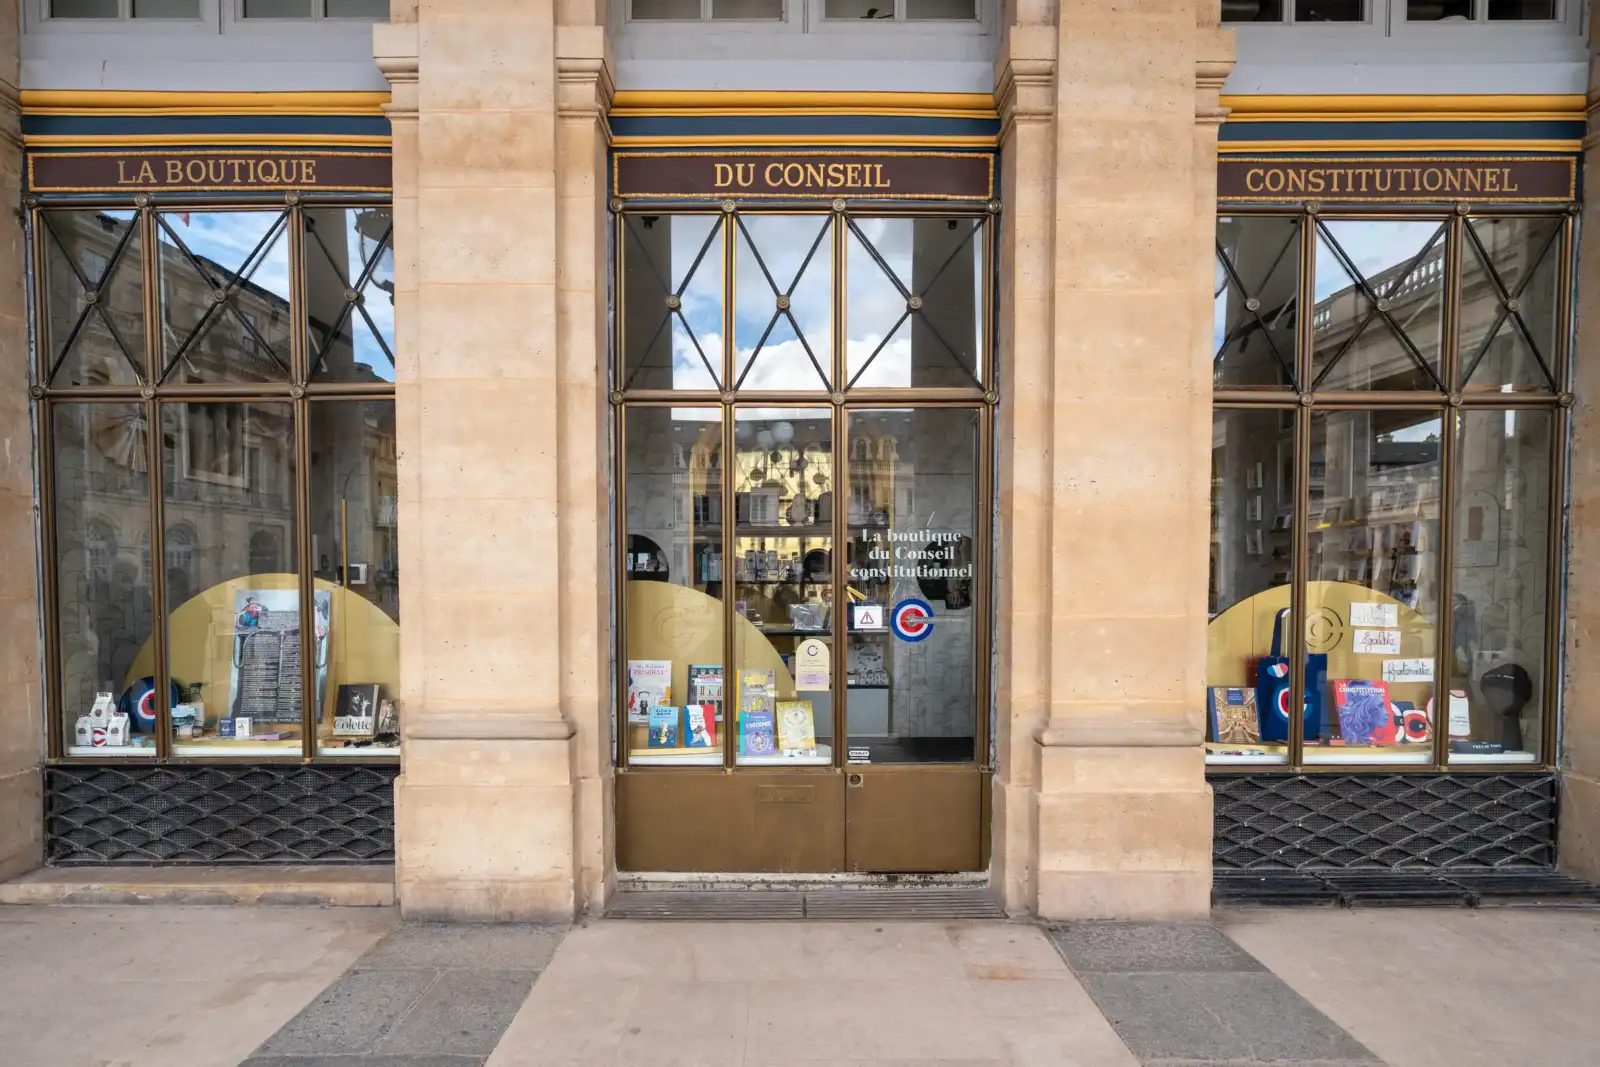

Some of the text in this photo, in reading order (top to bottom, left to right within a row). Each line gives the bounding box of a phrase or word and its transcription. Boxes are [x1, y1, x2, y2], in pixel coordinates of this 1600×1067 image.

[118, 159, 317, 184] LA BOUTIQUE
[714, 163, 891, 188] DU CONSEIL
[1246, 168, 1518, 192] CONSTITUTIONNEL
[862, 528, 962, 546] La boutique
[868, 546, 955, 560] du Conseil
[850, 563, 973, 578] constitutionnel
